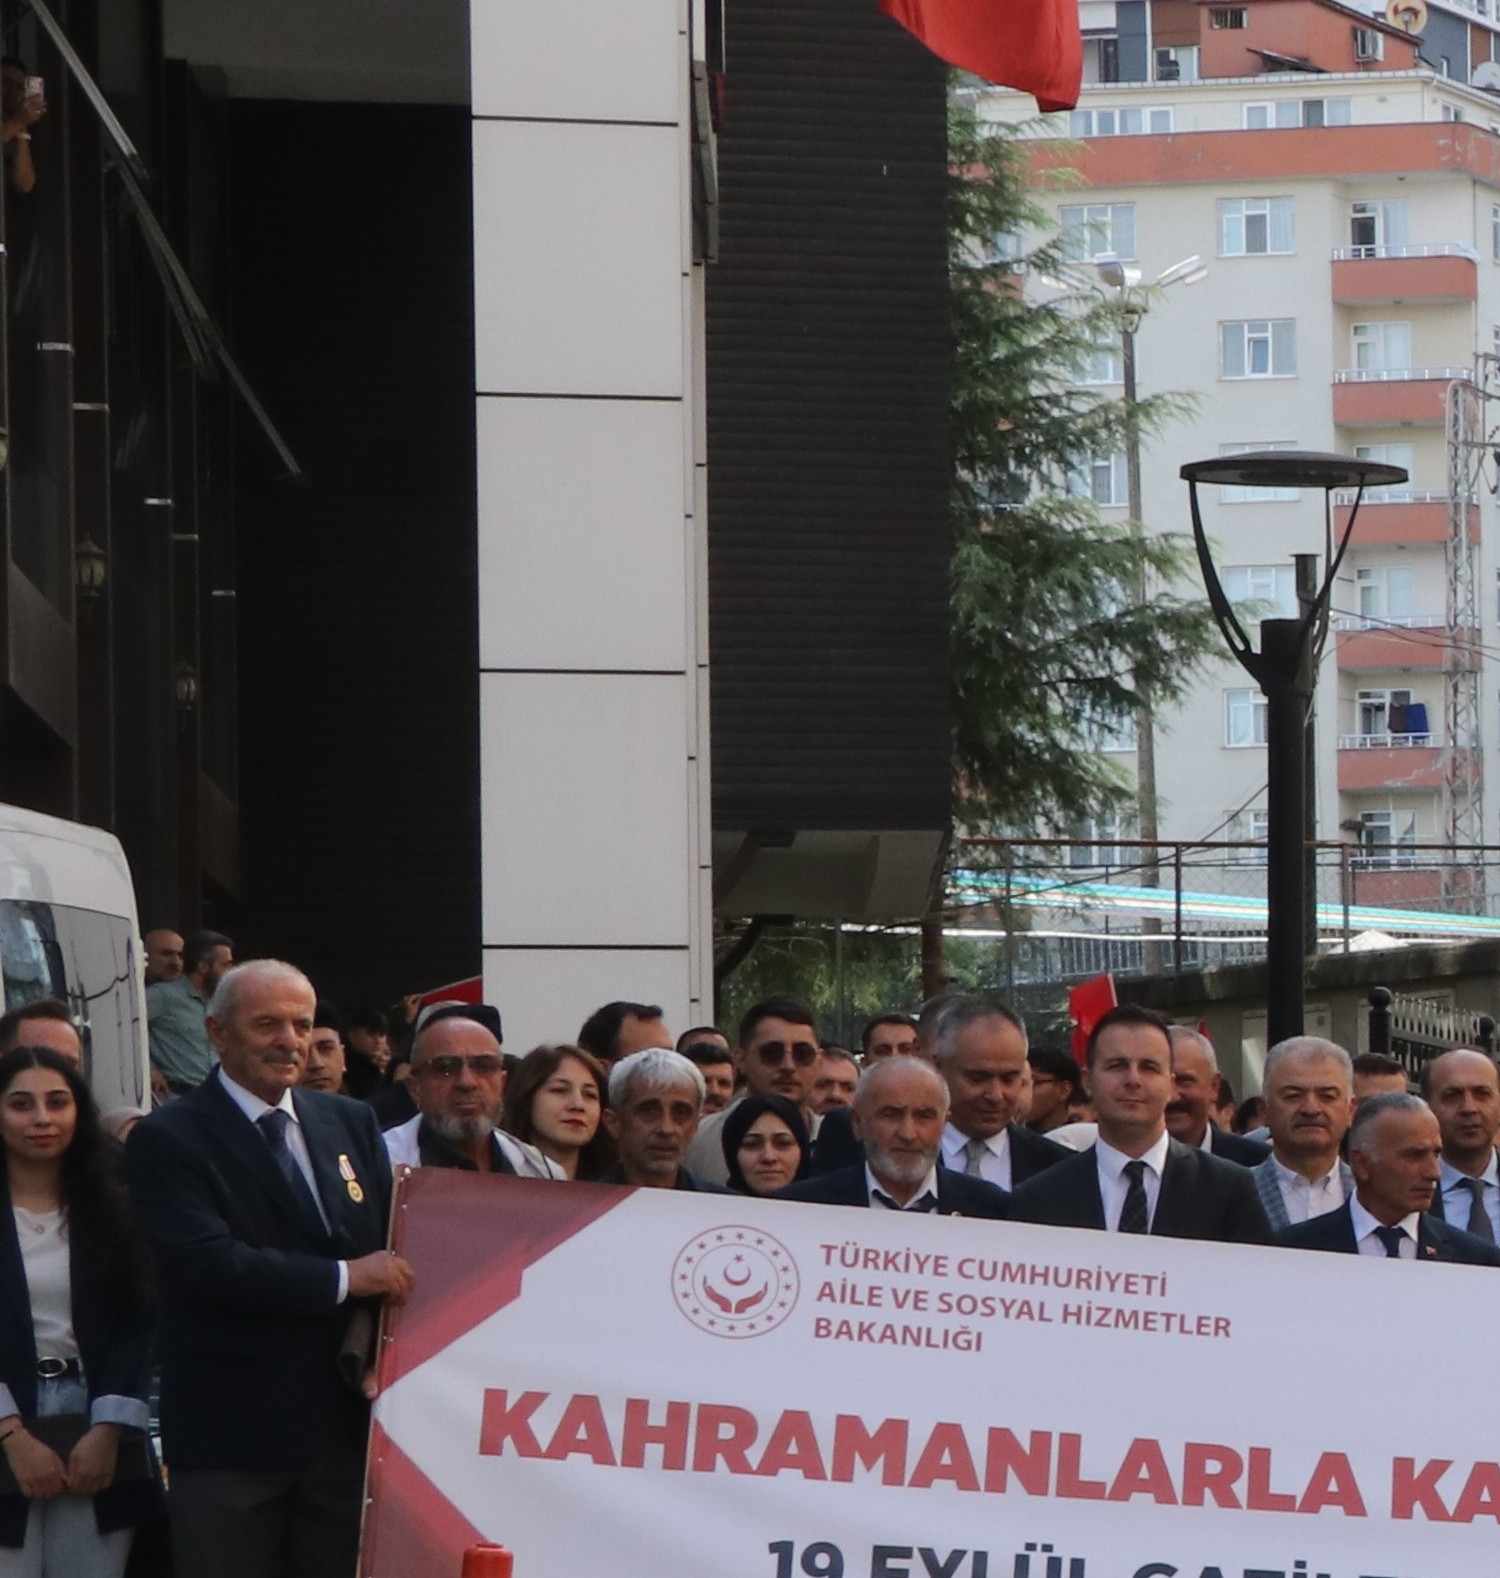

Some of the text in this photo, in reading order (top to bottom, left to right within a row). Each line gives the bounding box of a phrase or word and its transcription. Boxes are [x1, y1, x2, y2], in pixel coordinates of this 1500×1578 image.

[821, 1241, 1169, 1298] TÜRKİYE CUMHURİYETİ
[814, 1317, 984, 1353] BAKANLIĞI
[816, 1279, 1232, 1338] AİLE VE SOSYAL HİZMETLER
[478, 1388, 1367, 1517] KAHRAMANLARLA
